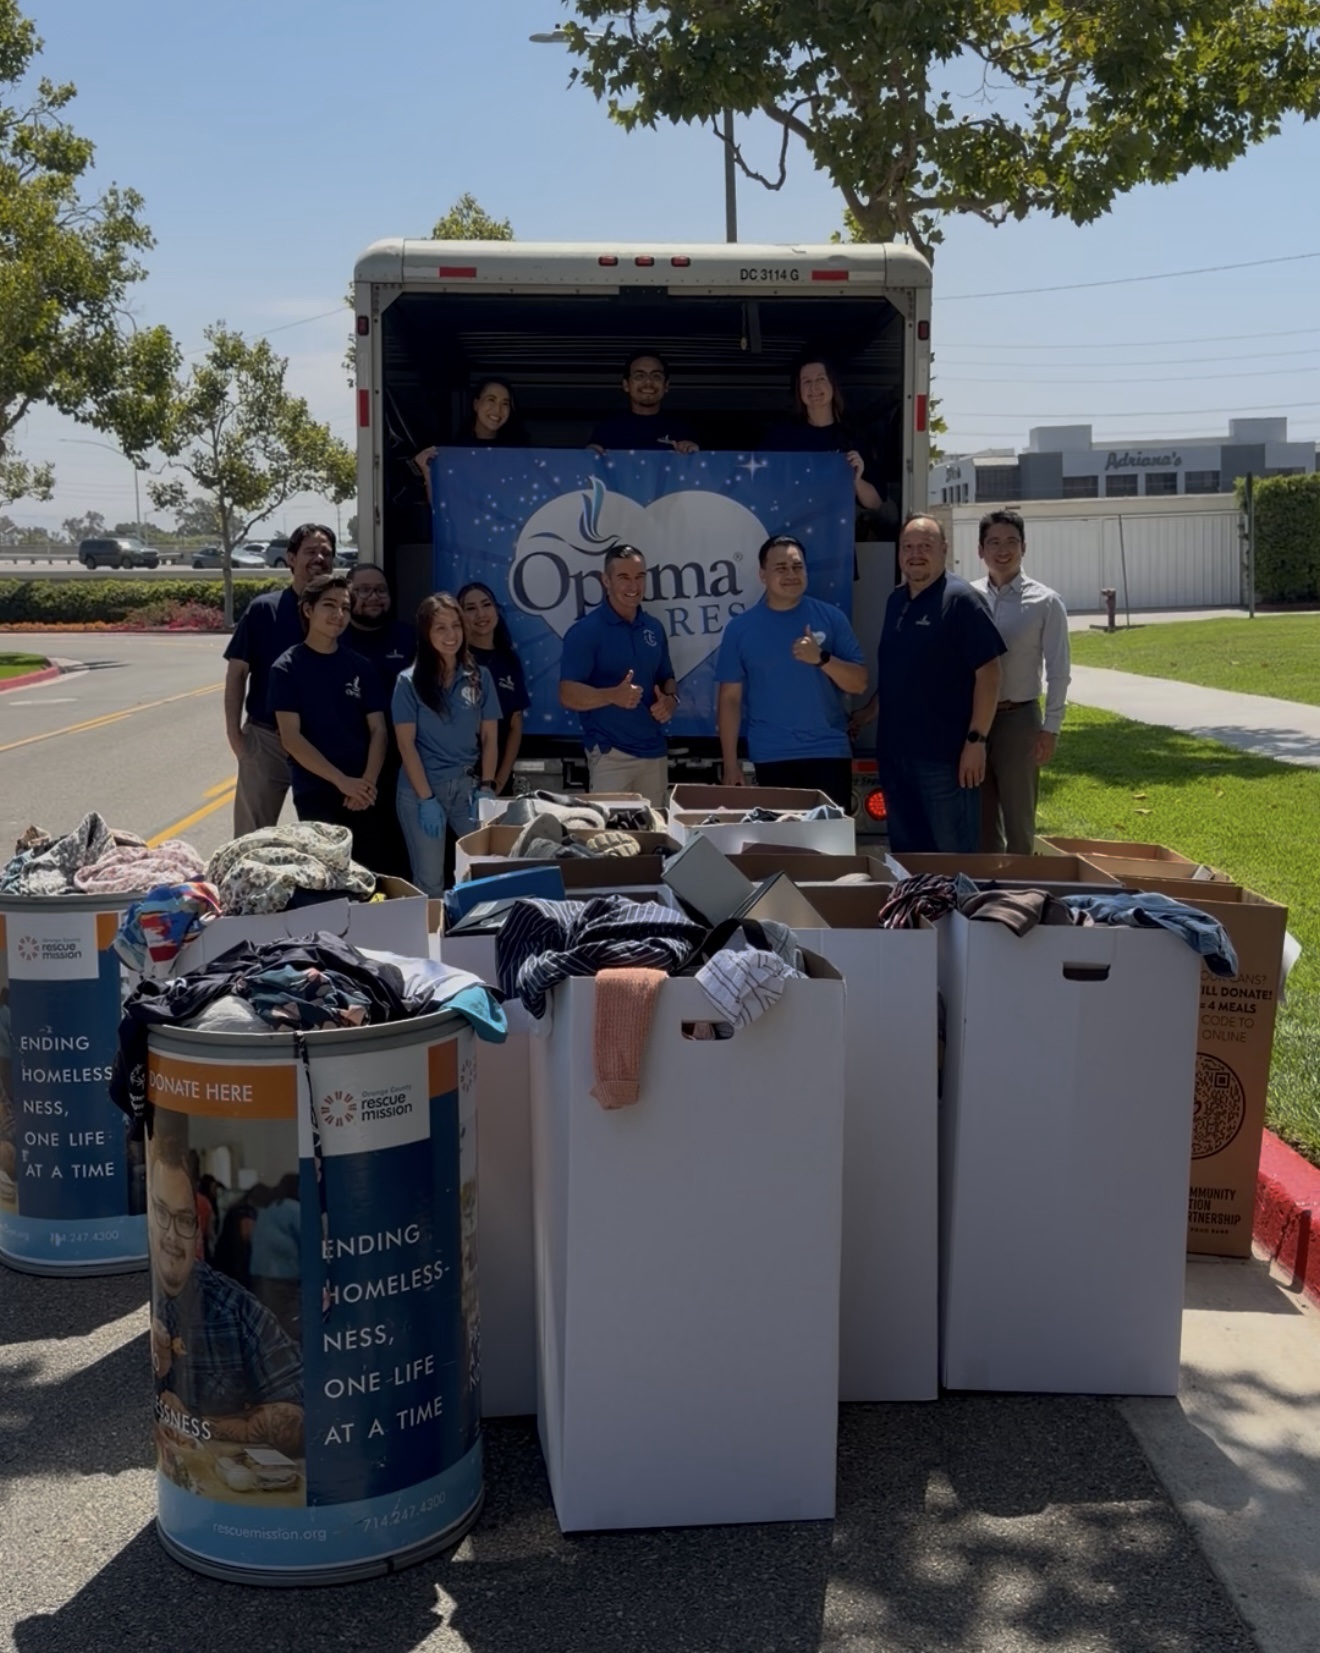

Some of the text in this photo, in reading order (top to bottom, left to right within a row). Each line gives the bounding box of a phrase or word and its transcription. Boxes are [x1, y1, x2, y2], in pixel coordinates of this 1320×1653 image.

[740, 268, 799, 281] DC 3114 G
[42, 942, 76, 951] rescue
[42, 950, 82, 960] mission
[1201, 985, 1273, 1000] ILL DONATE!
[1208, 1001, 1216, 1010] 4
[1218, 1001, 1257, 1014] MEALS
[1201, 1014, 1255, 1029] CODE TO
[21, 1036, 90, 1051] ENDING
[1201, 1029, 1247, 1043] ONLINE
[149, 1070, 253, 1102] DONATE HERE
[23, 1100, 69, 1118] NESS,
[361, 1093, 406, 1110] rescue
[361, 1103, 413, 1121] mission
[24, 1131, 105, 1147] ONE LIFE
[25, 1162, 115, 1179] AT A TIME
[1189, 1186, 1236, 1201] MMUNITY
[1188, 1198, 1211, 1211] TION
[1188, 1211, 1241, 1226] RTNERSHIP
[322, 1224, 420, 1259] ENDING
[322, 1260, 450, 1305] HOMELESS-
[323, 1324, 395, 1353] NESS,
[324, 1371, 381, 1399] ONE
[394, 1354, 435, 1386] LIFE
[324, 1395, 443, 1446] AT A TIME
[213, 1491, 447, 1542] rescuemission.org 714.247.4300
